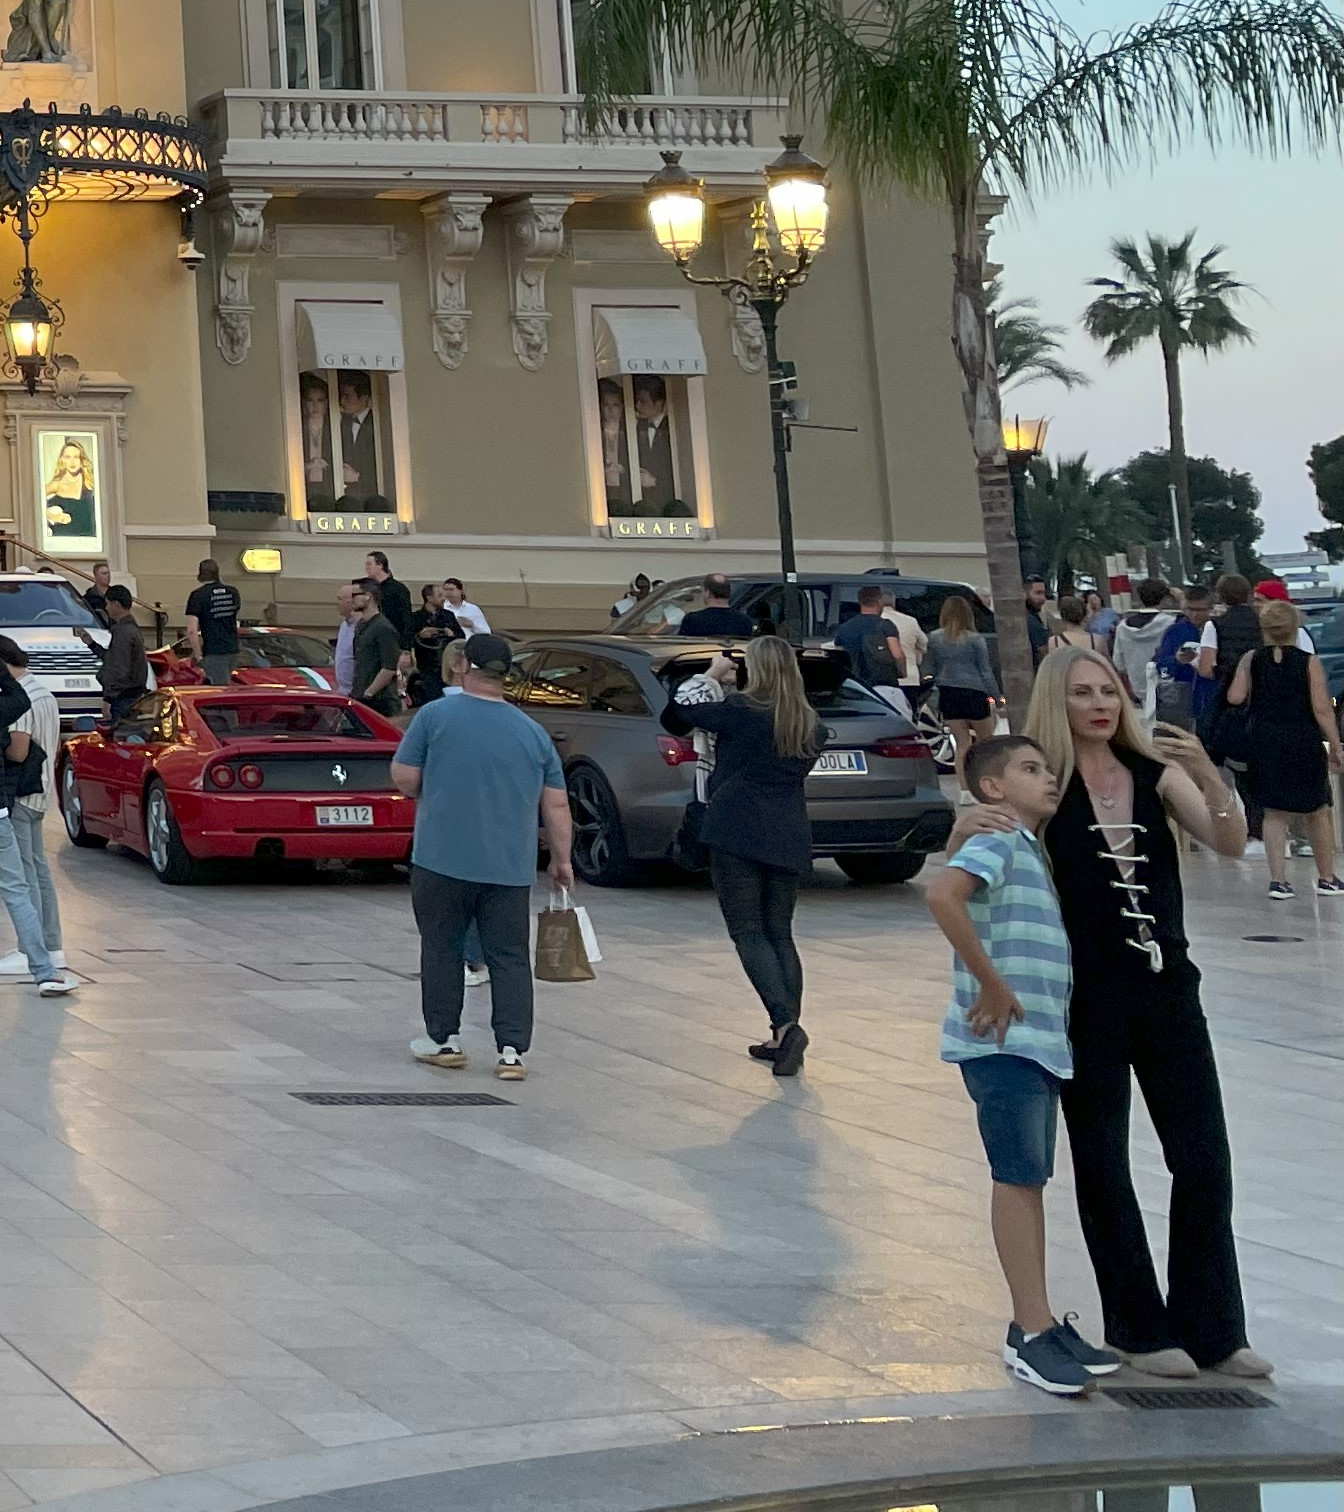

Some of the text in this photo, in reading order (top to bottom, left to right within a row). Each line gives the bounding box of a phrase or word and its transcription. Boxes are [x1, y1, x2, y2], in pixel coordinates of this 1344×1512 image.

[324, 354, 400, 367] GRAFF
[627, 359, 700, 370] GRAFF
[317, 517, 392, 530] GRAFF
[619, 522, 693, 535] GRAFF
[333, 808, 369, 820] 3112
